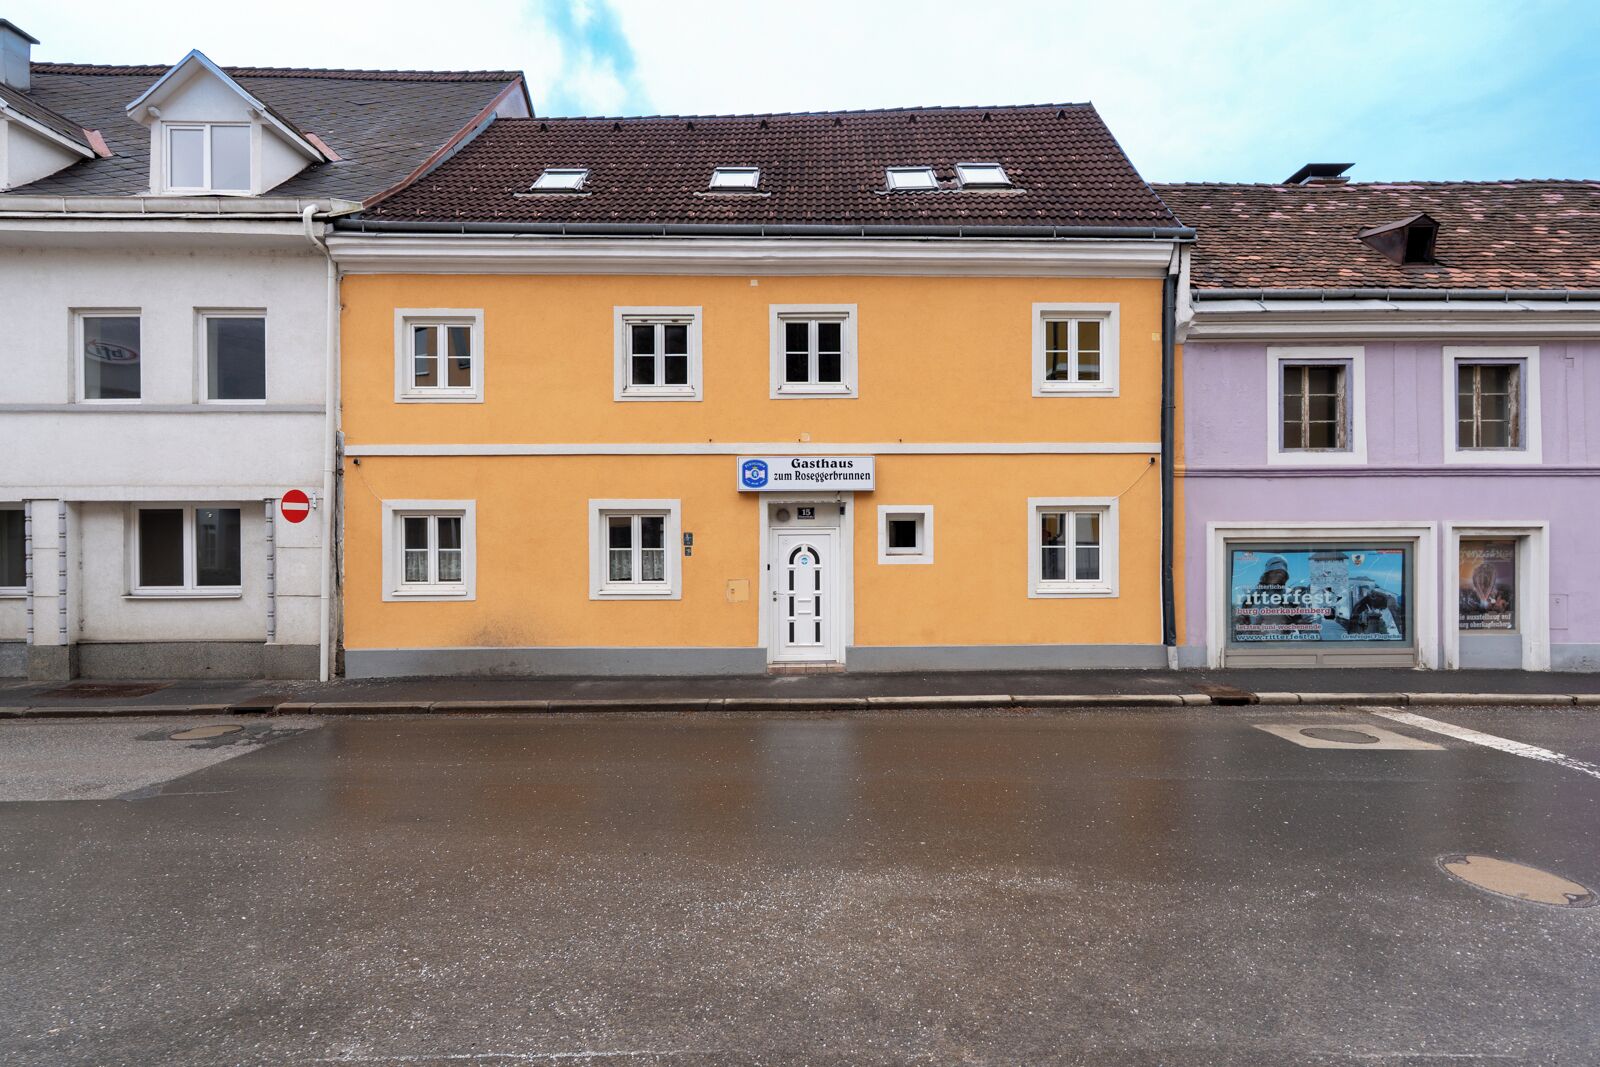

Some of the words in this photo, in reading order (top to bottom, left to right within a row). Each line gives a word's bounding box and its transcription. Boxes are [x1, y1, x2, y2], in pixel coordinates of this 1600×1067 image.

[791, 458, 854, 469] Gasthaus
[773, 472, 792, 481] zum
[795, 470, 871, 483] Roseggerbrunnen
[802, 508, 811, 516] 15
[1236, 590, 1333, 605] ritterfest
[1236, 608, 1258, 616] burg
[1260, 607, 1332, 616] oberkapfenberg
